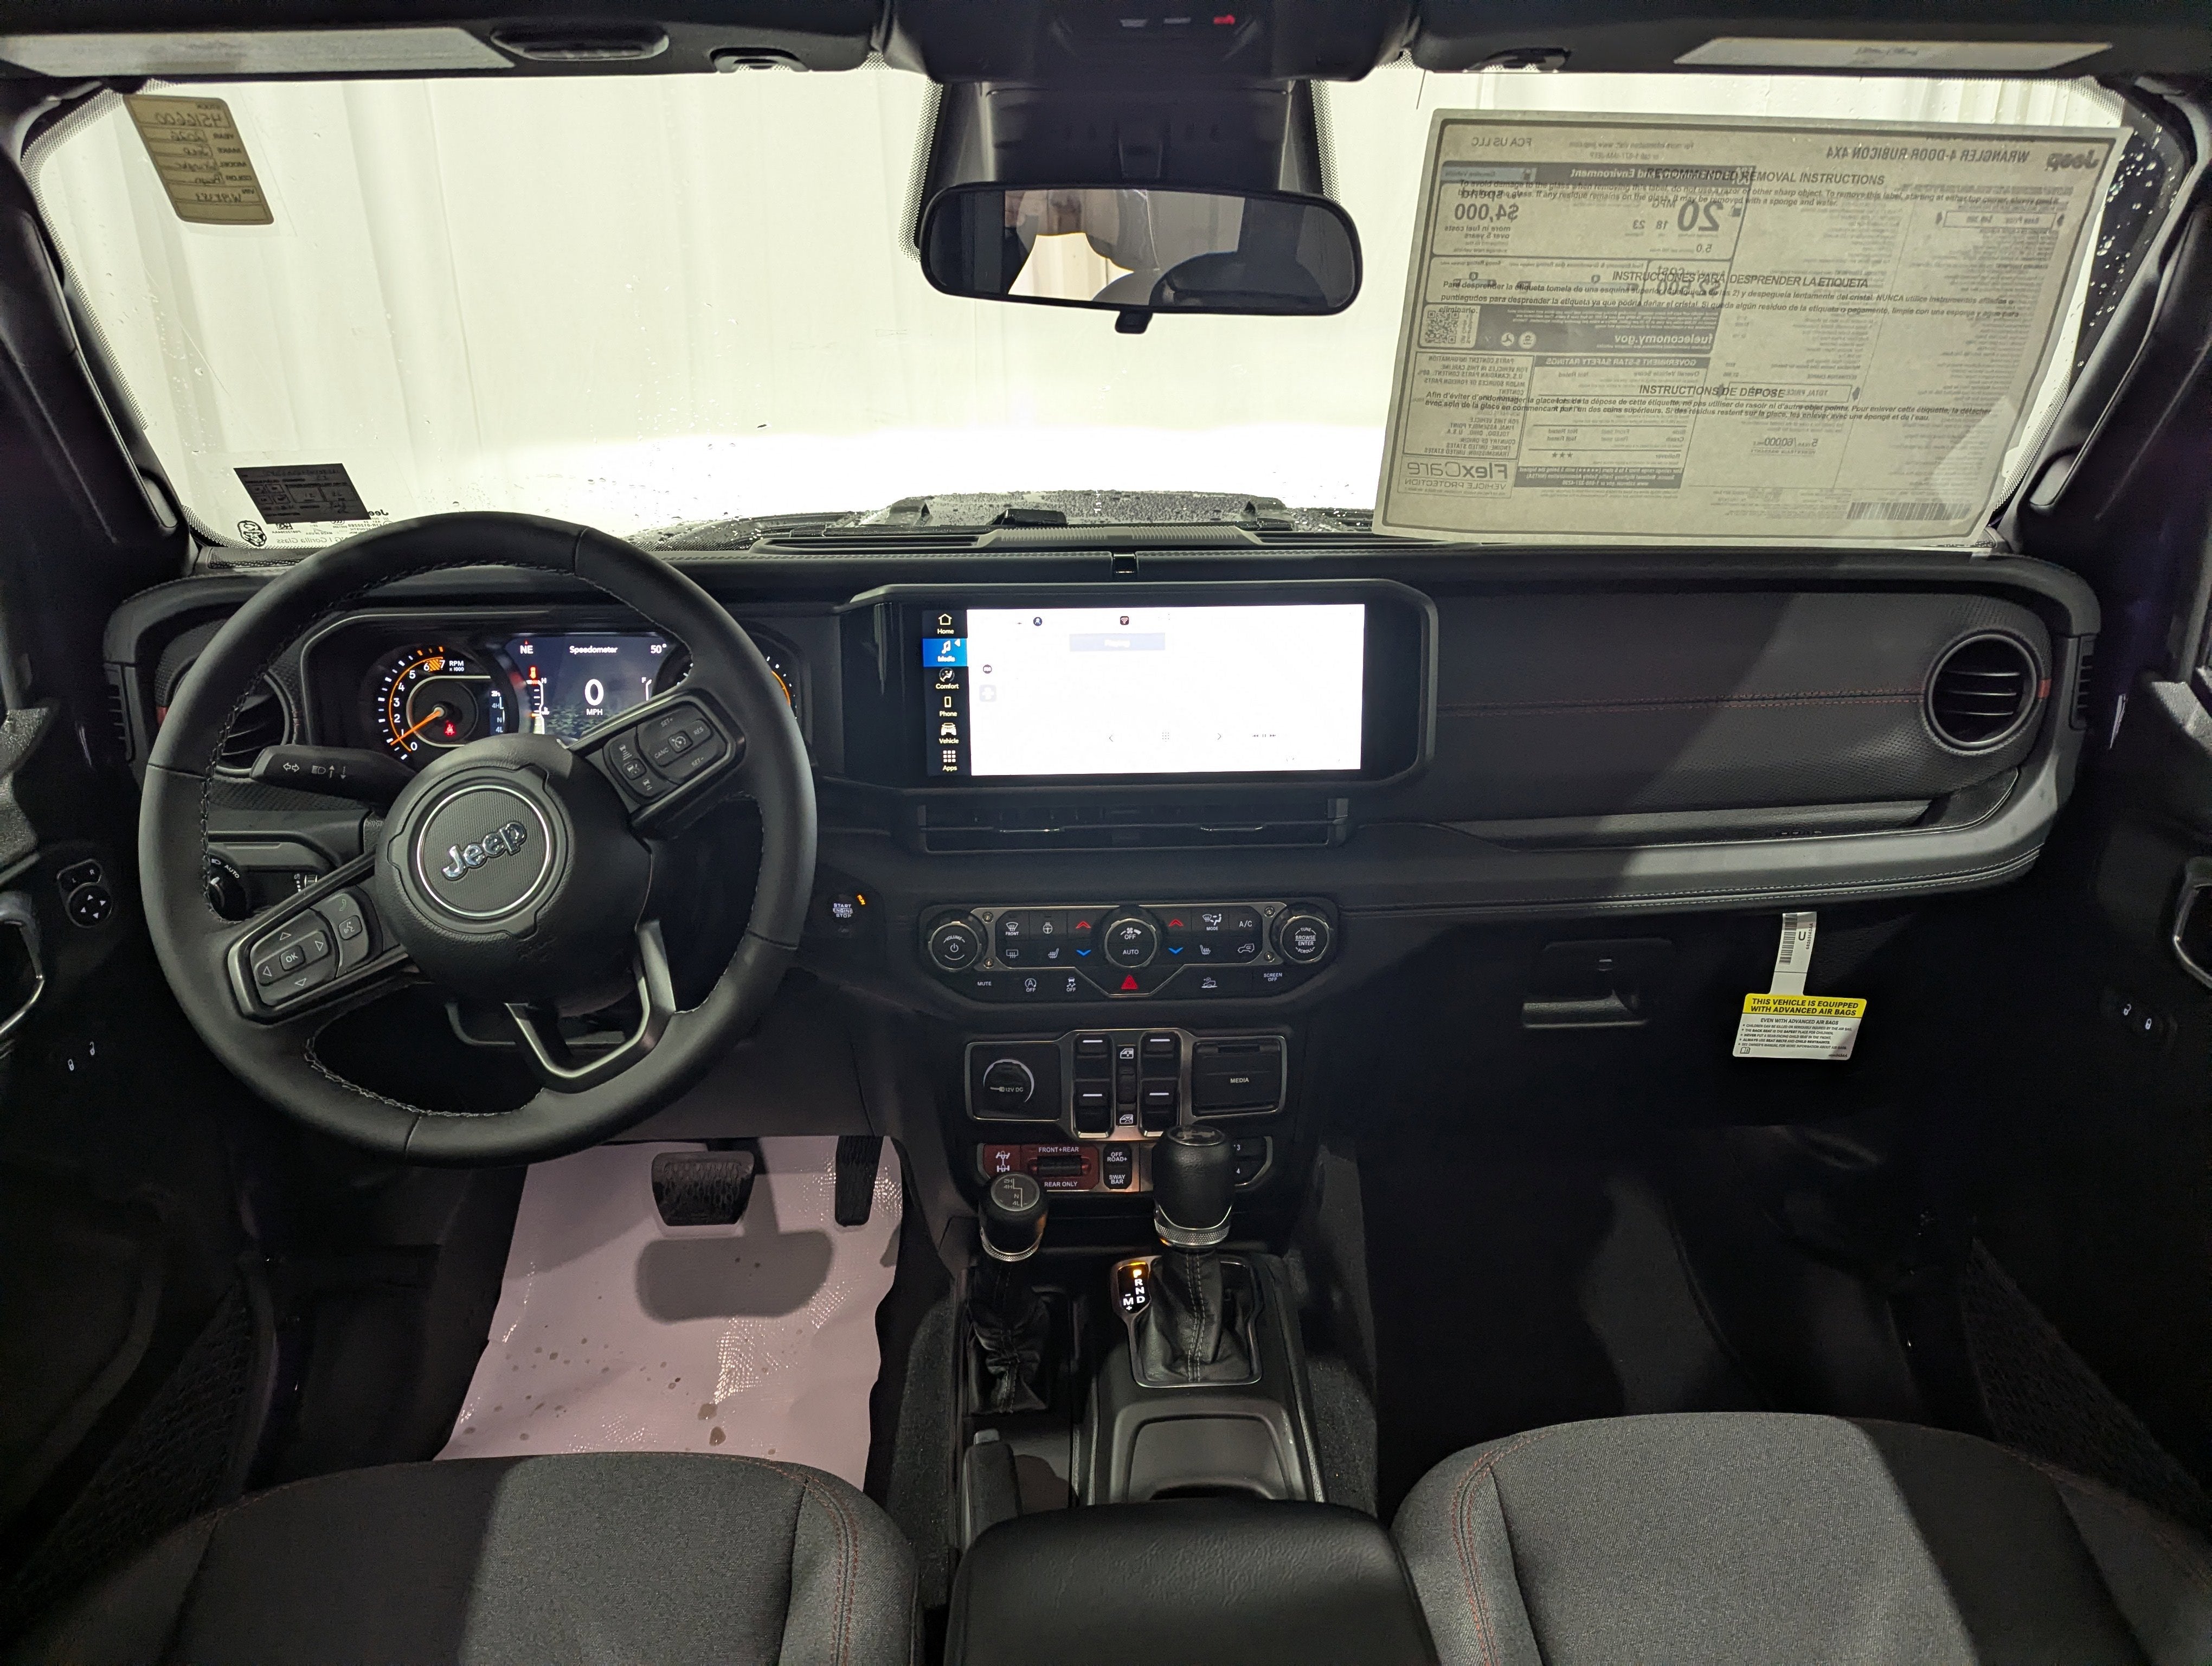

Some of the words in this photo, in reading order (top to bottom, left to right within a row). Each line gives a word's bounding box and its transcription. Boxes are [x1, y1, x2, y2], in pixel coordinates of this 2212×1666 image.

[1741, 171, 1796, 183] REMOVAL
[1799, 172, 1885, 185] INSTRUCTIONS
[1729, 274, 1802, 287] DESPRENDER
[1803, 277, 1816, 287] LA
[1817, 277, 1869, 289] ETIQUETA
[1639, 385, 1719, 396] INSTRUCTIONS
[1740, 386, 1786, 398] DÉPOSE
[520, 645, 533, 654] NE
[569, 645, 619, 655] Speedometer
[651, 643, 667, 654] 50°
[423, 662, 430, 671] 6
[439, 659, 445, 669] 7
[409, 670, 416, 680] 5
[398, 682, 406, 691] 4
[584, 678, 604, 706] 0
[393, 697, 400, 707] 3
[394, 714, 401, 723] 2
[410, 742, 418, 751] 0
[654, 747, 669, 759] CANC
[441, 820, 528, 882] Jeep
[224, 864, 240, 879] AUTO
[857, 894, 866, 906] RUN
[1798, 931, 1806, 941] U
[285, 952, 299, 963] OK
[1772, 998, 1806, 1007] VEHICLE
[1817, 1001, 1859, 1009] EQUIPPED
[1133, 1270, 1142, 1278] P
[1134, 1278, 1143, 1286] R
[1135, 1286, 1144, 1295] N
[1123, 1297, 1134, 1306] M
[1136, 1296, 1145, 1304] D
